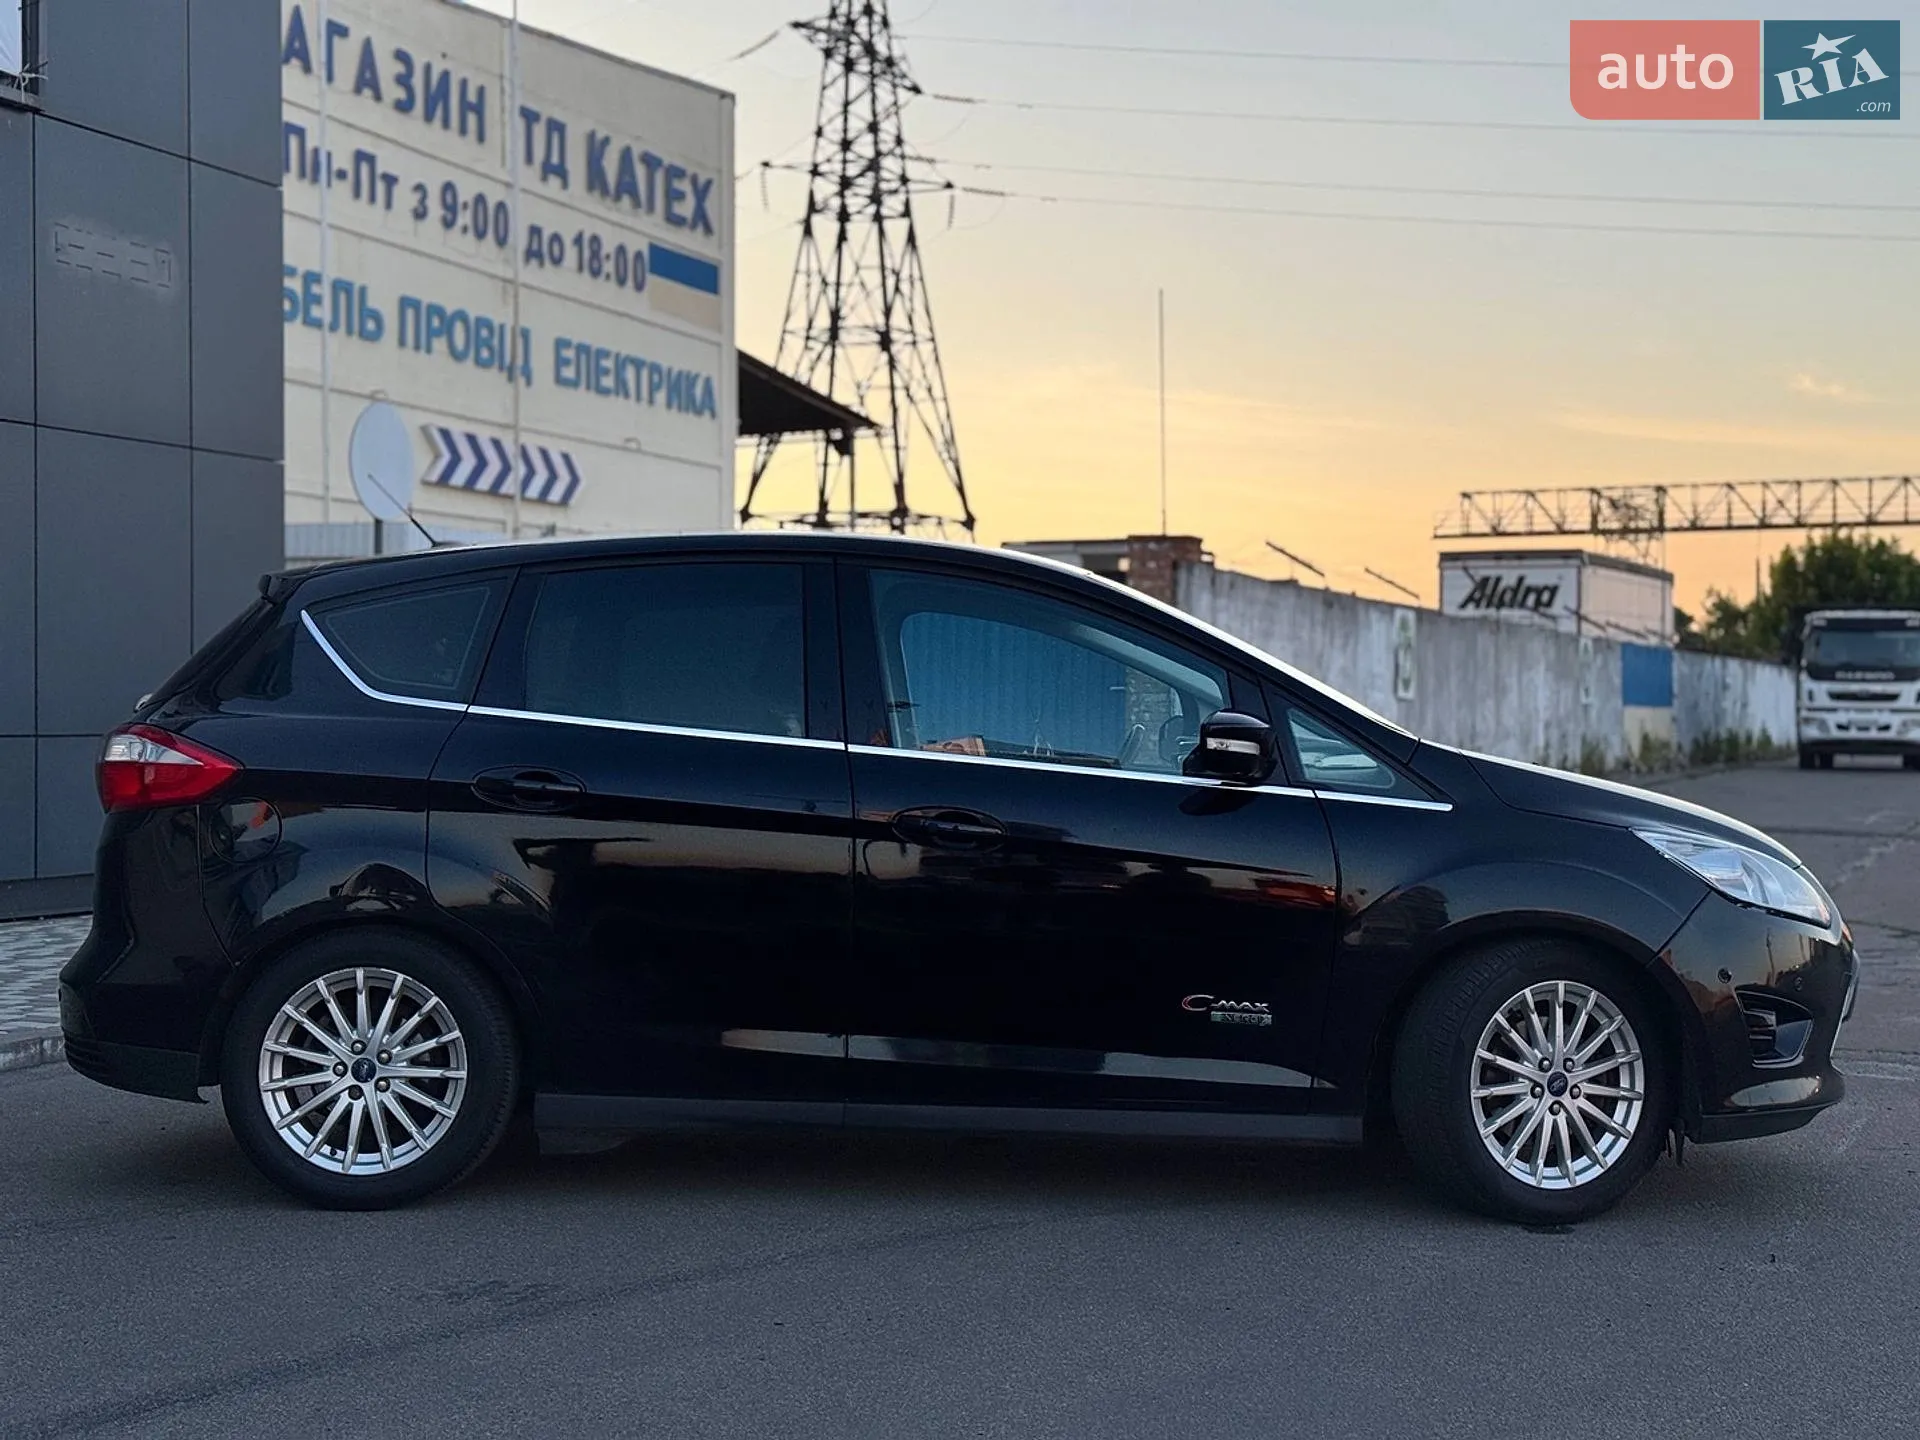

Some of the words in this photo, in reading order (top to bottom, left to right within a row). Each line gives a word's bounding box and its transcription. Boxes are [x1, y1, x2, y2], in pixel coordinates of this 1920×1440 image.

[519, 104, 569, 191] ТД
[586, 129, 714, 237] КАТЕХ
[440, 180, 509, 248] 9:00
[525, 223, 564, 269] до
[572, 229, 646, 294] 18:00
[554, 337, 717, 419] ЕЛЕКТРИКА
[1458, 575, 1560, 611] Aldra
